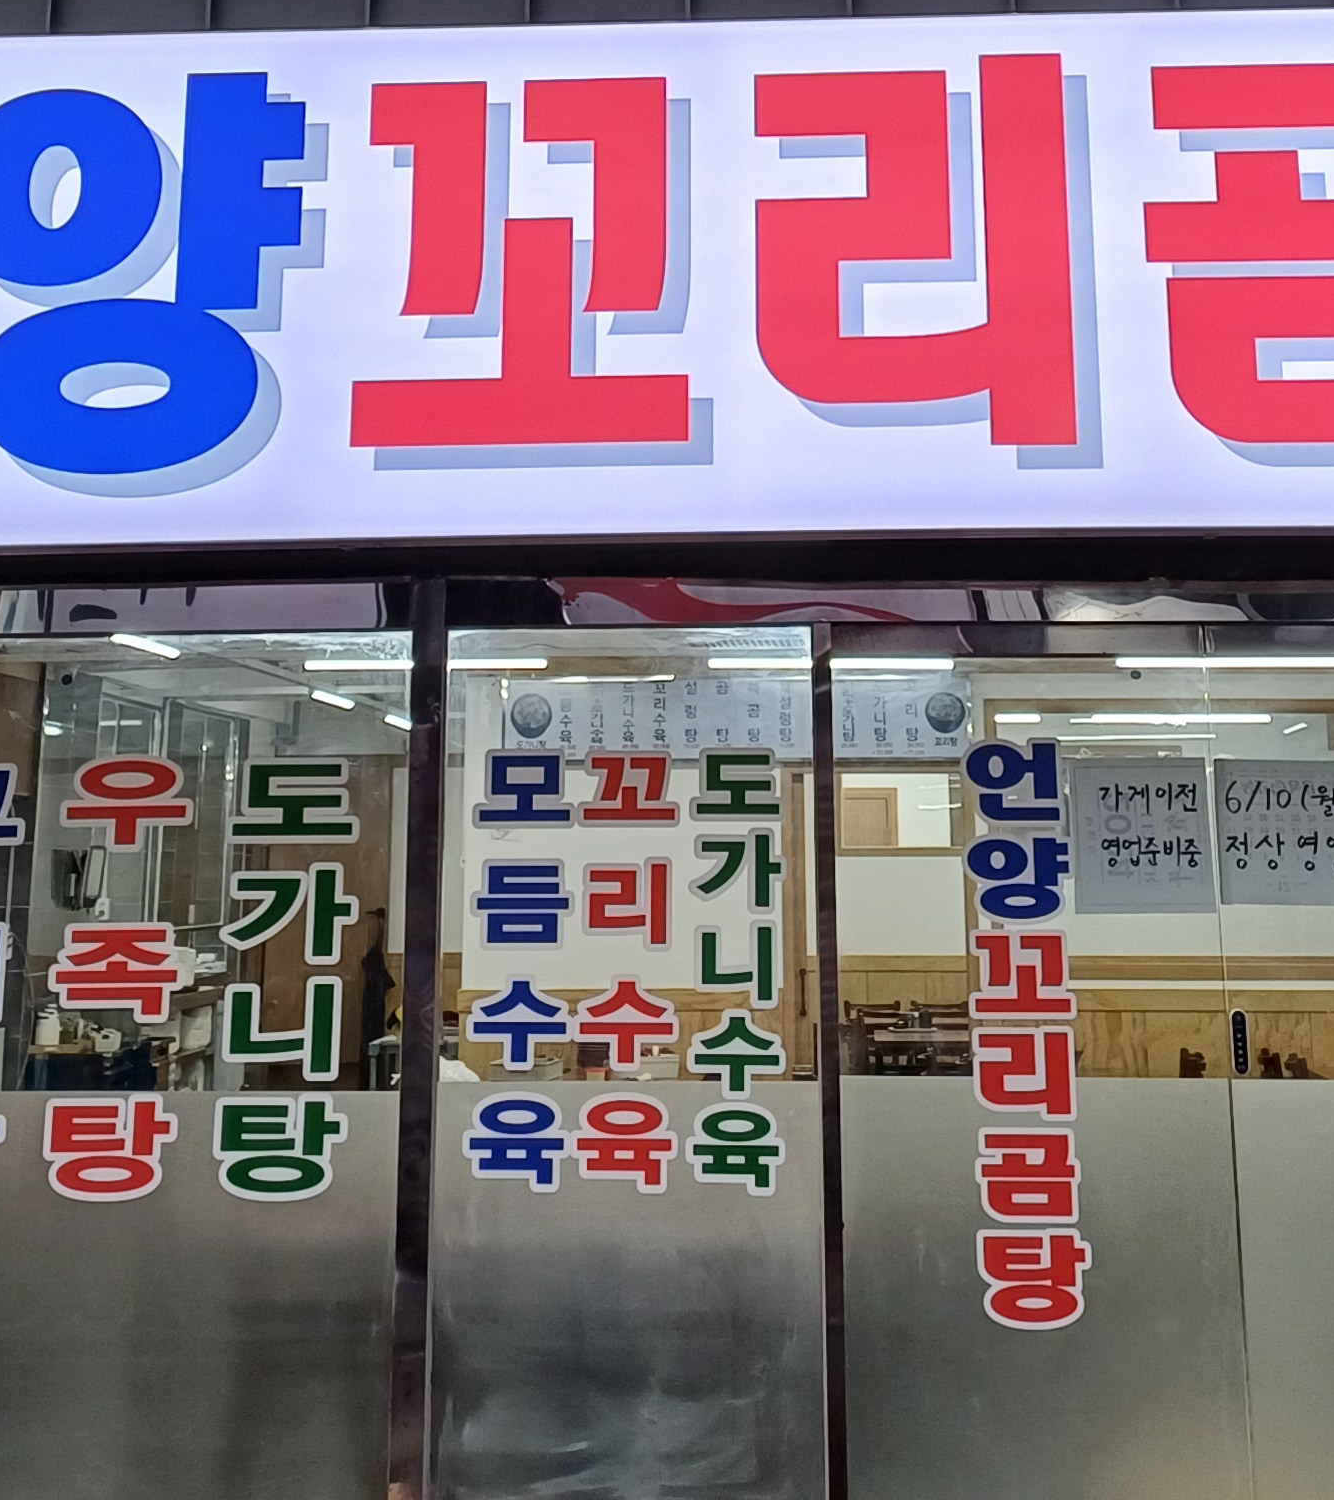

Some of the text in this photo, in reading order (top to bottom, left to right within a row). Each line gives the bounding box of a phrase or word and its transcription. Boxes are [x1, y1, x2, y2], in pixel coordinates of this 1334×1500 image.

[48, 759, 189, 1195] 우족탕
[215, 762, 354, 1194] 도가니탕
[468, 753, 573, 1186] 모듬수육
[574, 756, 678, 1186] 꼬리수육
[690, 752, 783, 1189] 도가니수육
